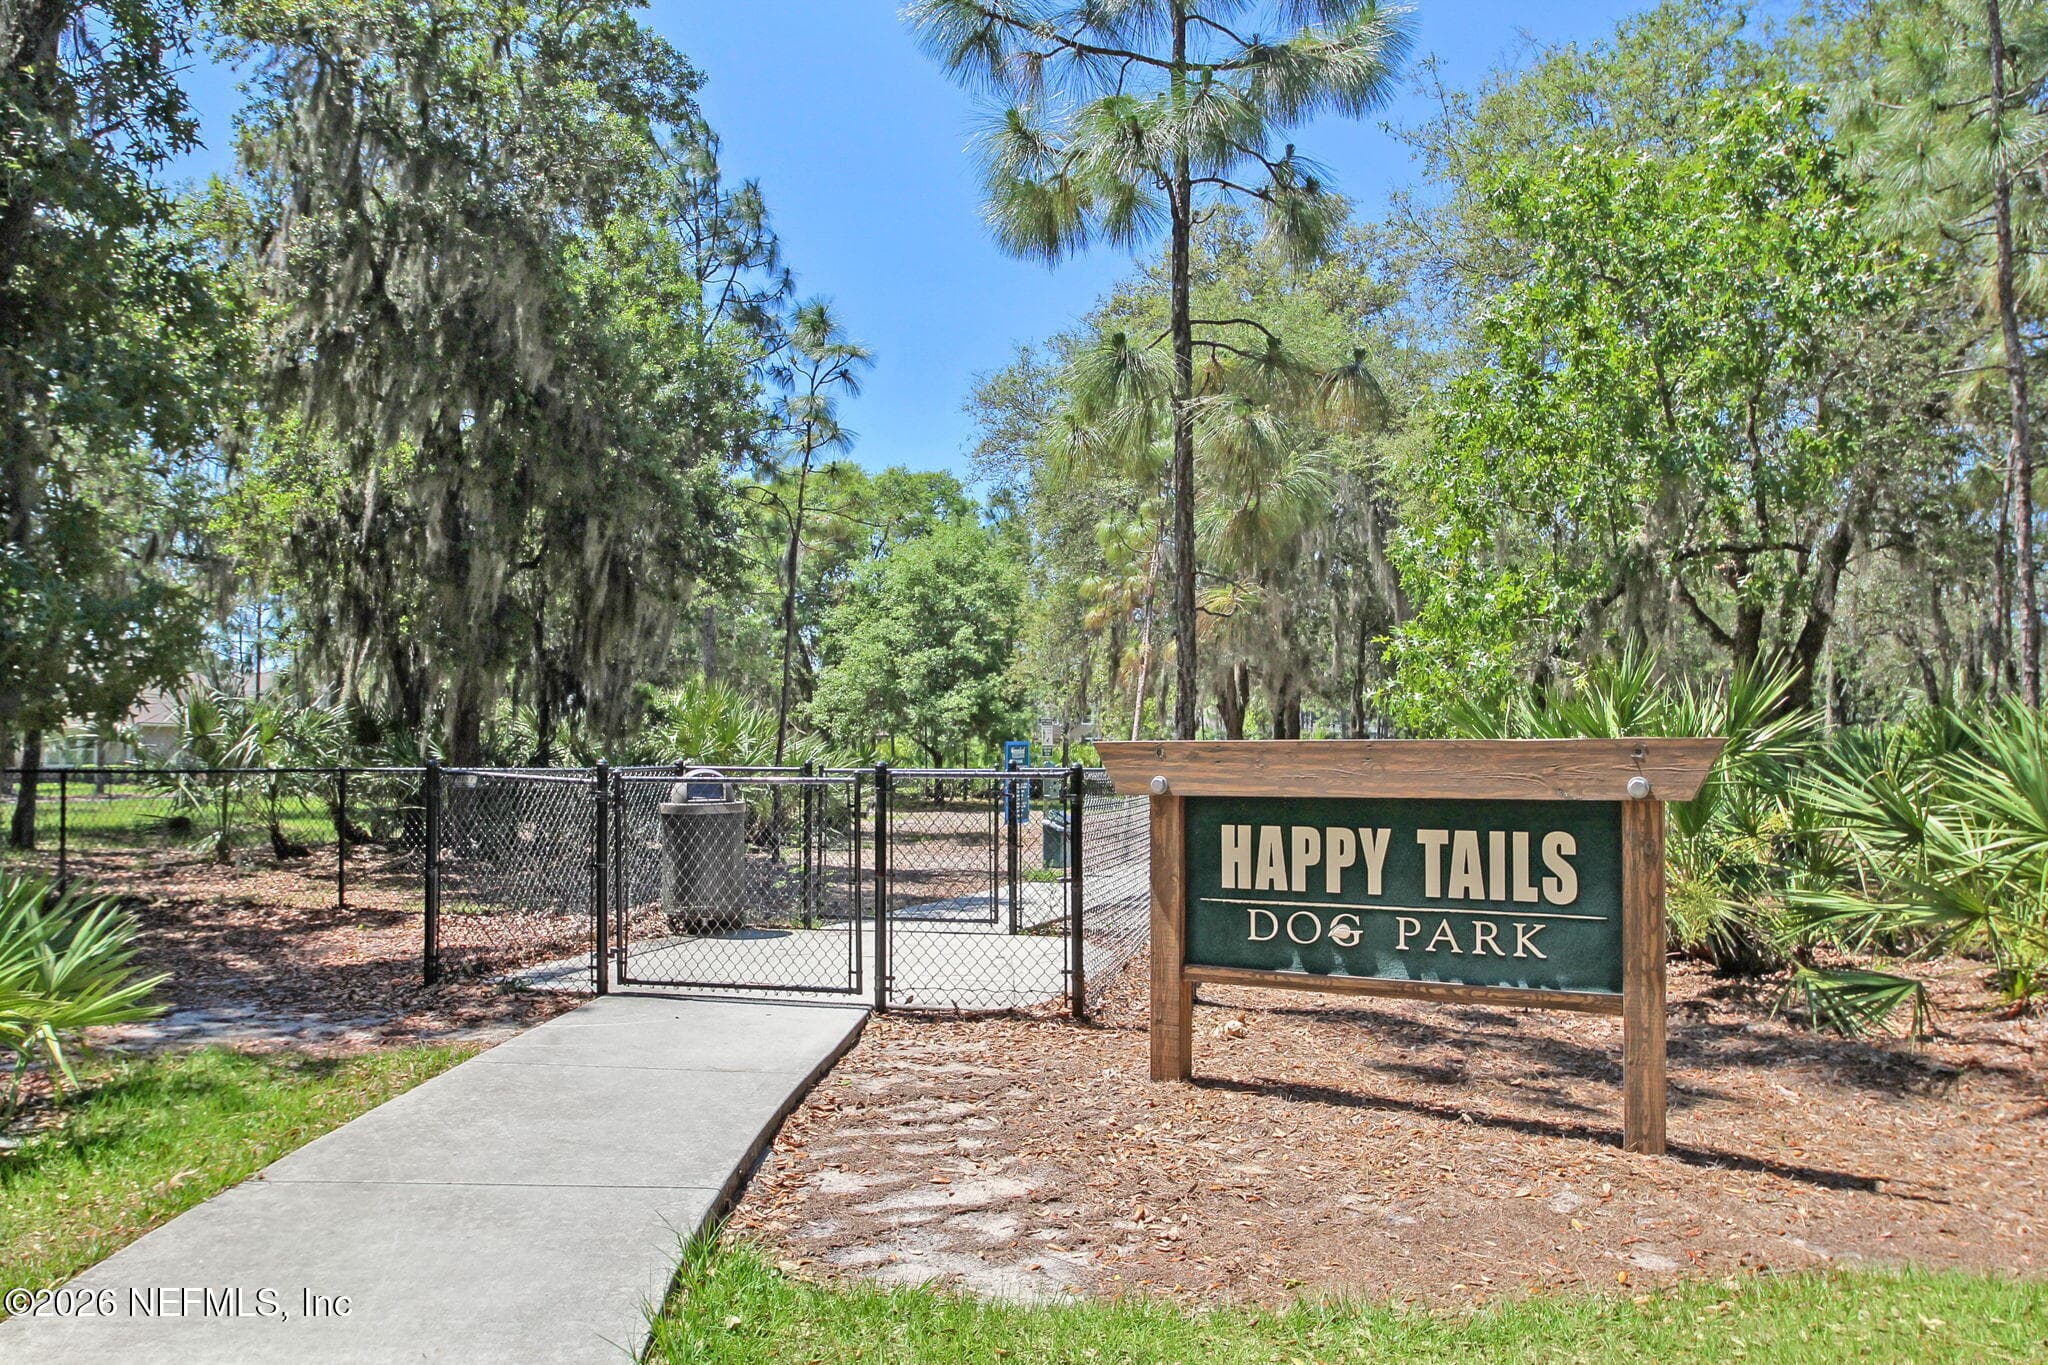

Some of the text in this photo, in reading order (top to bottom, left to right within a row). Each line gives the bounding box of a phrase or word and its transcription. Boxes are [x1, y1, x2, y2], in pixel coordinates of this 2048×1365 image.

[1220, 824, 1577, 905] HAPPY TAILS
[1247, 908, 1547, 958] DOG PARK
